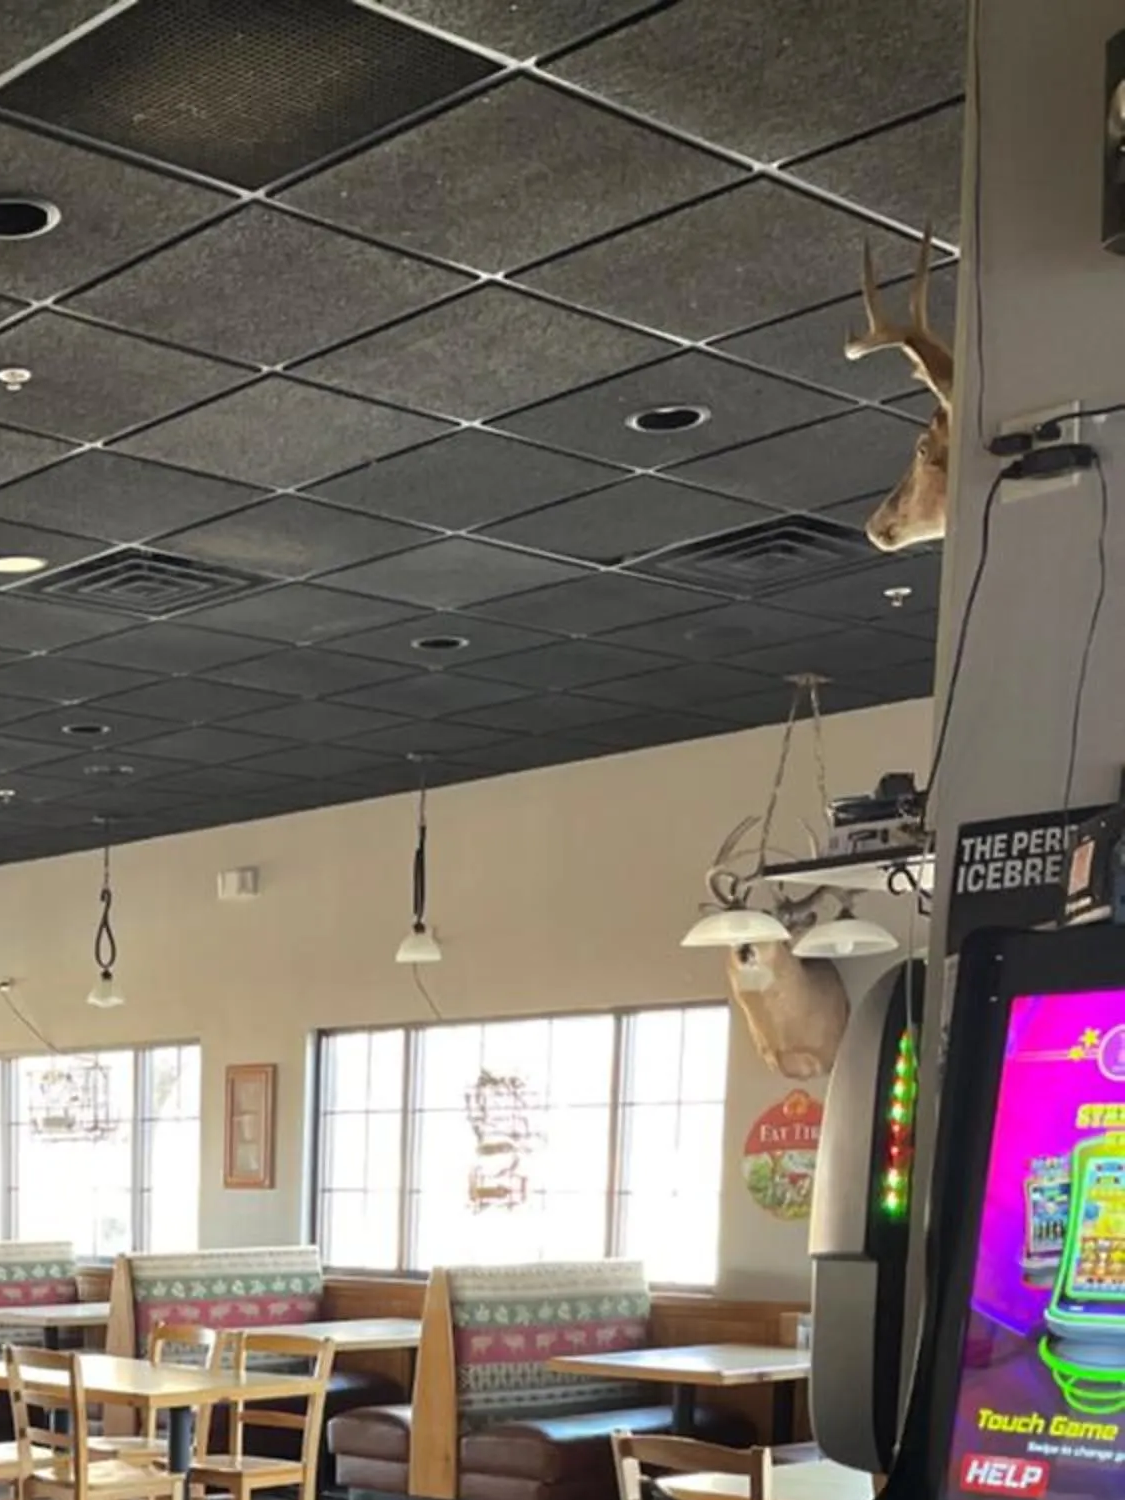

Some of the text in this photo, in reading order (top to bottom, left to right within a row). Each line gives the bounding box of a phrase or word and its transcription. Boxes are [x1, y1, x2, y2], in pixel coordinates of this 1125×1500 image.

[960, 833, 1008, 863] THE
[978, 1408, 1119, 1441] Touch Game
[966, 1459, 1044, 1489] HELP
